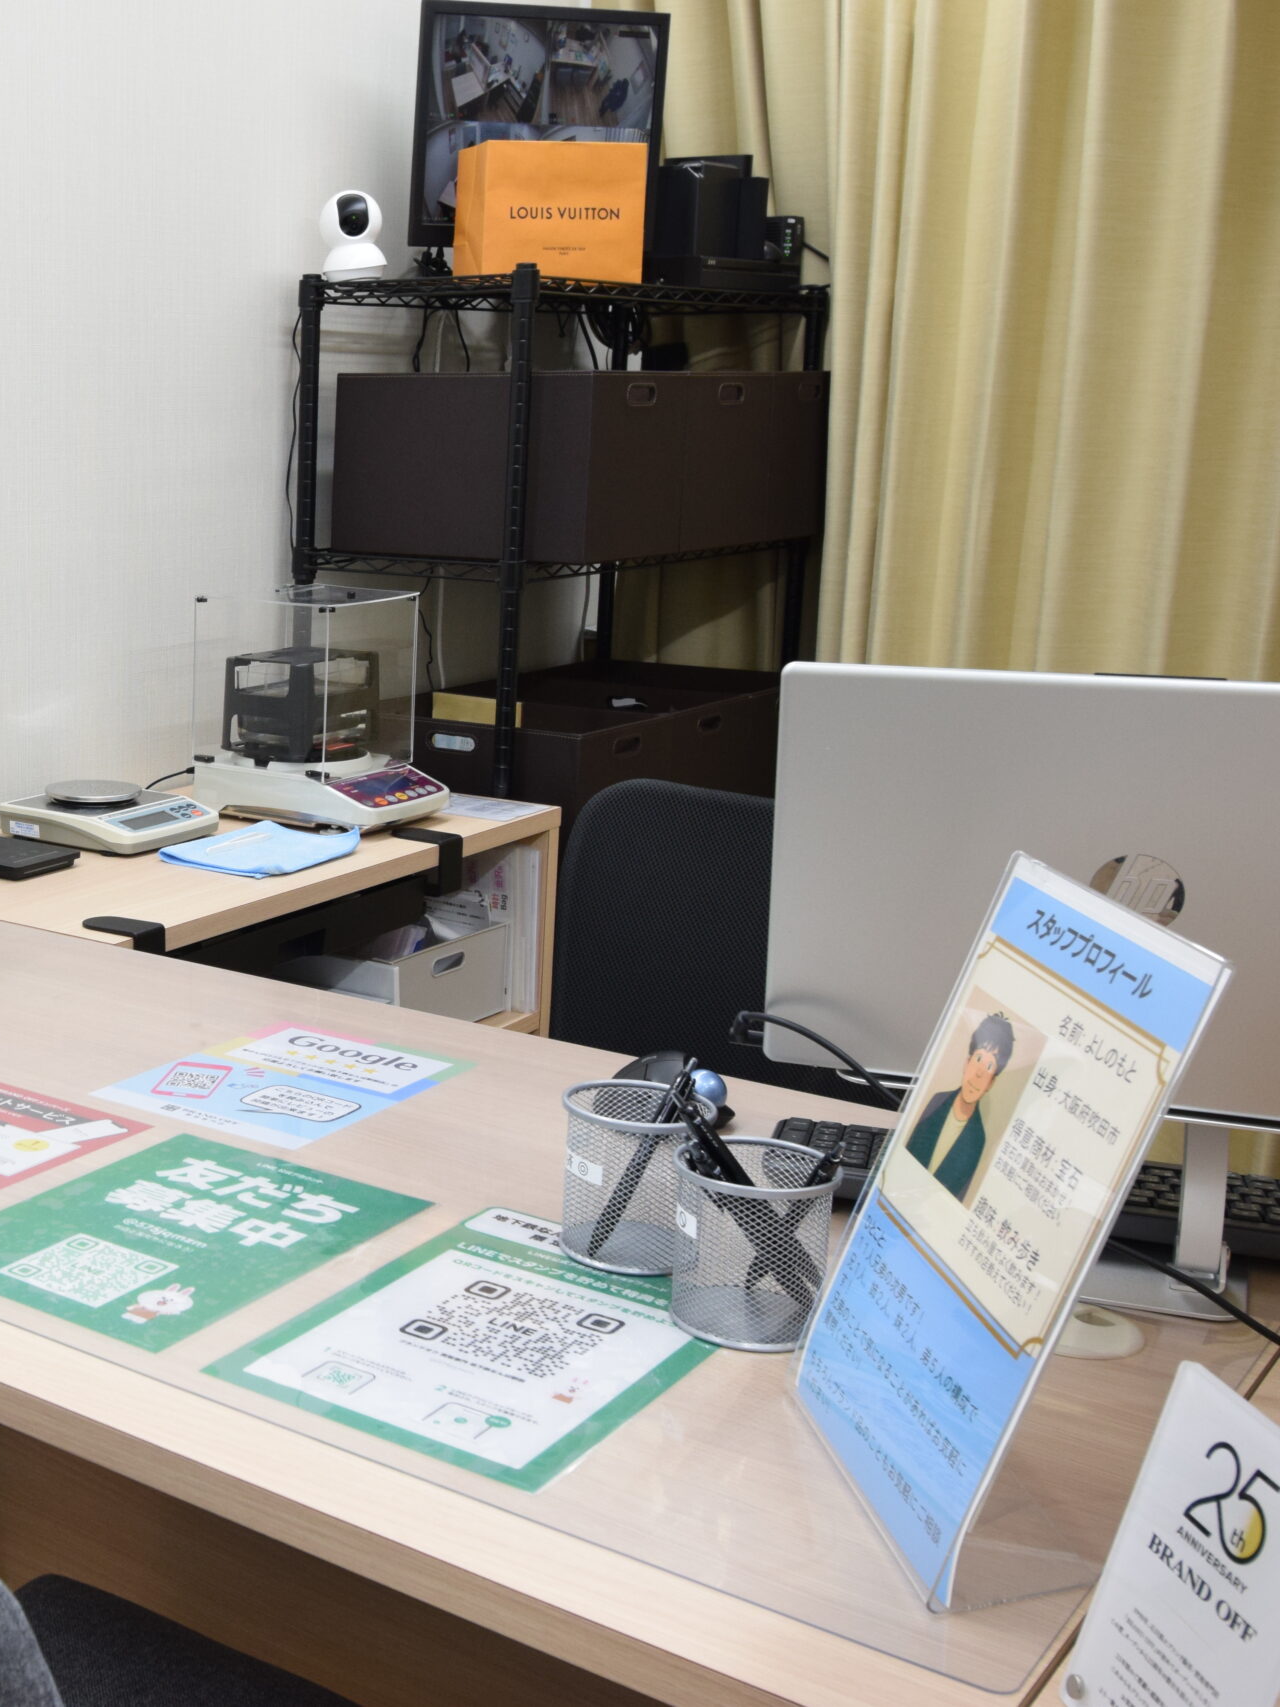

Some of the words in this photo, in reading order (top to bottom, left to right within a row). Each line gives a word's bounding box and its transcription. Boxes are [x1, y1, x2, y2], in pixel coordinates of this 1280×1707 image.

[509, 206, 553, 220] LOUIS
[557, 207, 620, 220] VUITTON
[1026, 909, 1153, 999] スタッフプロフィール
[287, 1035, 419, 1072] Google
[104, 1179, 308, 1249] 募集中
[155, 1157, 360, 1224] 友だち
[489, 1315, 537, 1337] LINE
[1183, 1441, 1280, 1566] 25
[1177, 1526, 1249, 1594] ANNIVERSARY
[1230, 1527, 1248, 1557] th
[1146, 1532, 1213, 1603] BRAND
[1215, 1599, 1258, 1644] OFF
